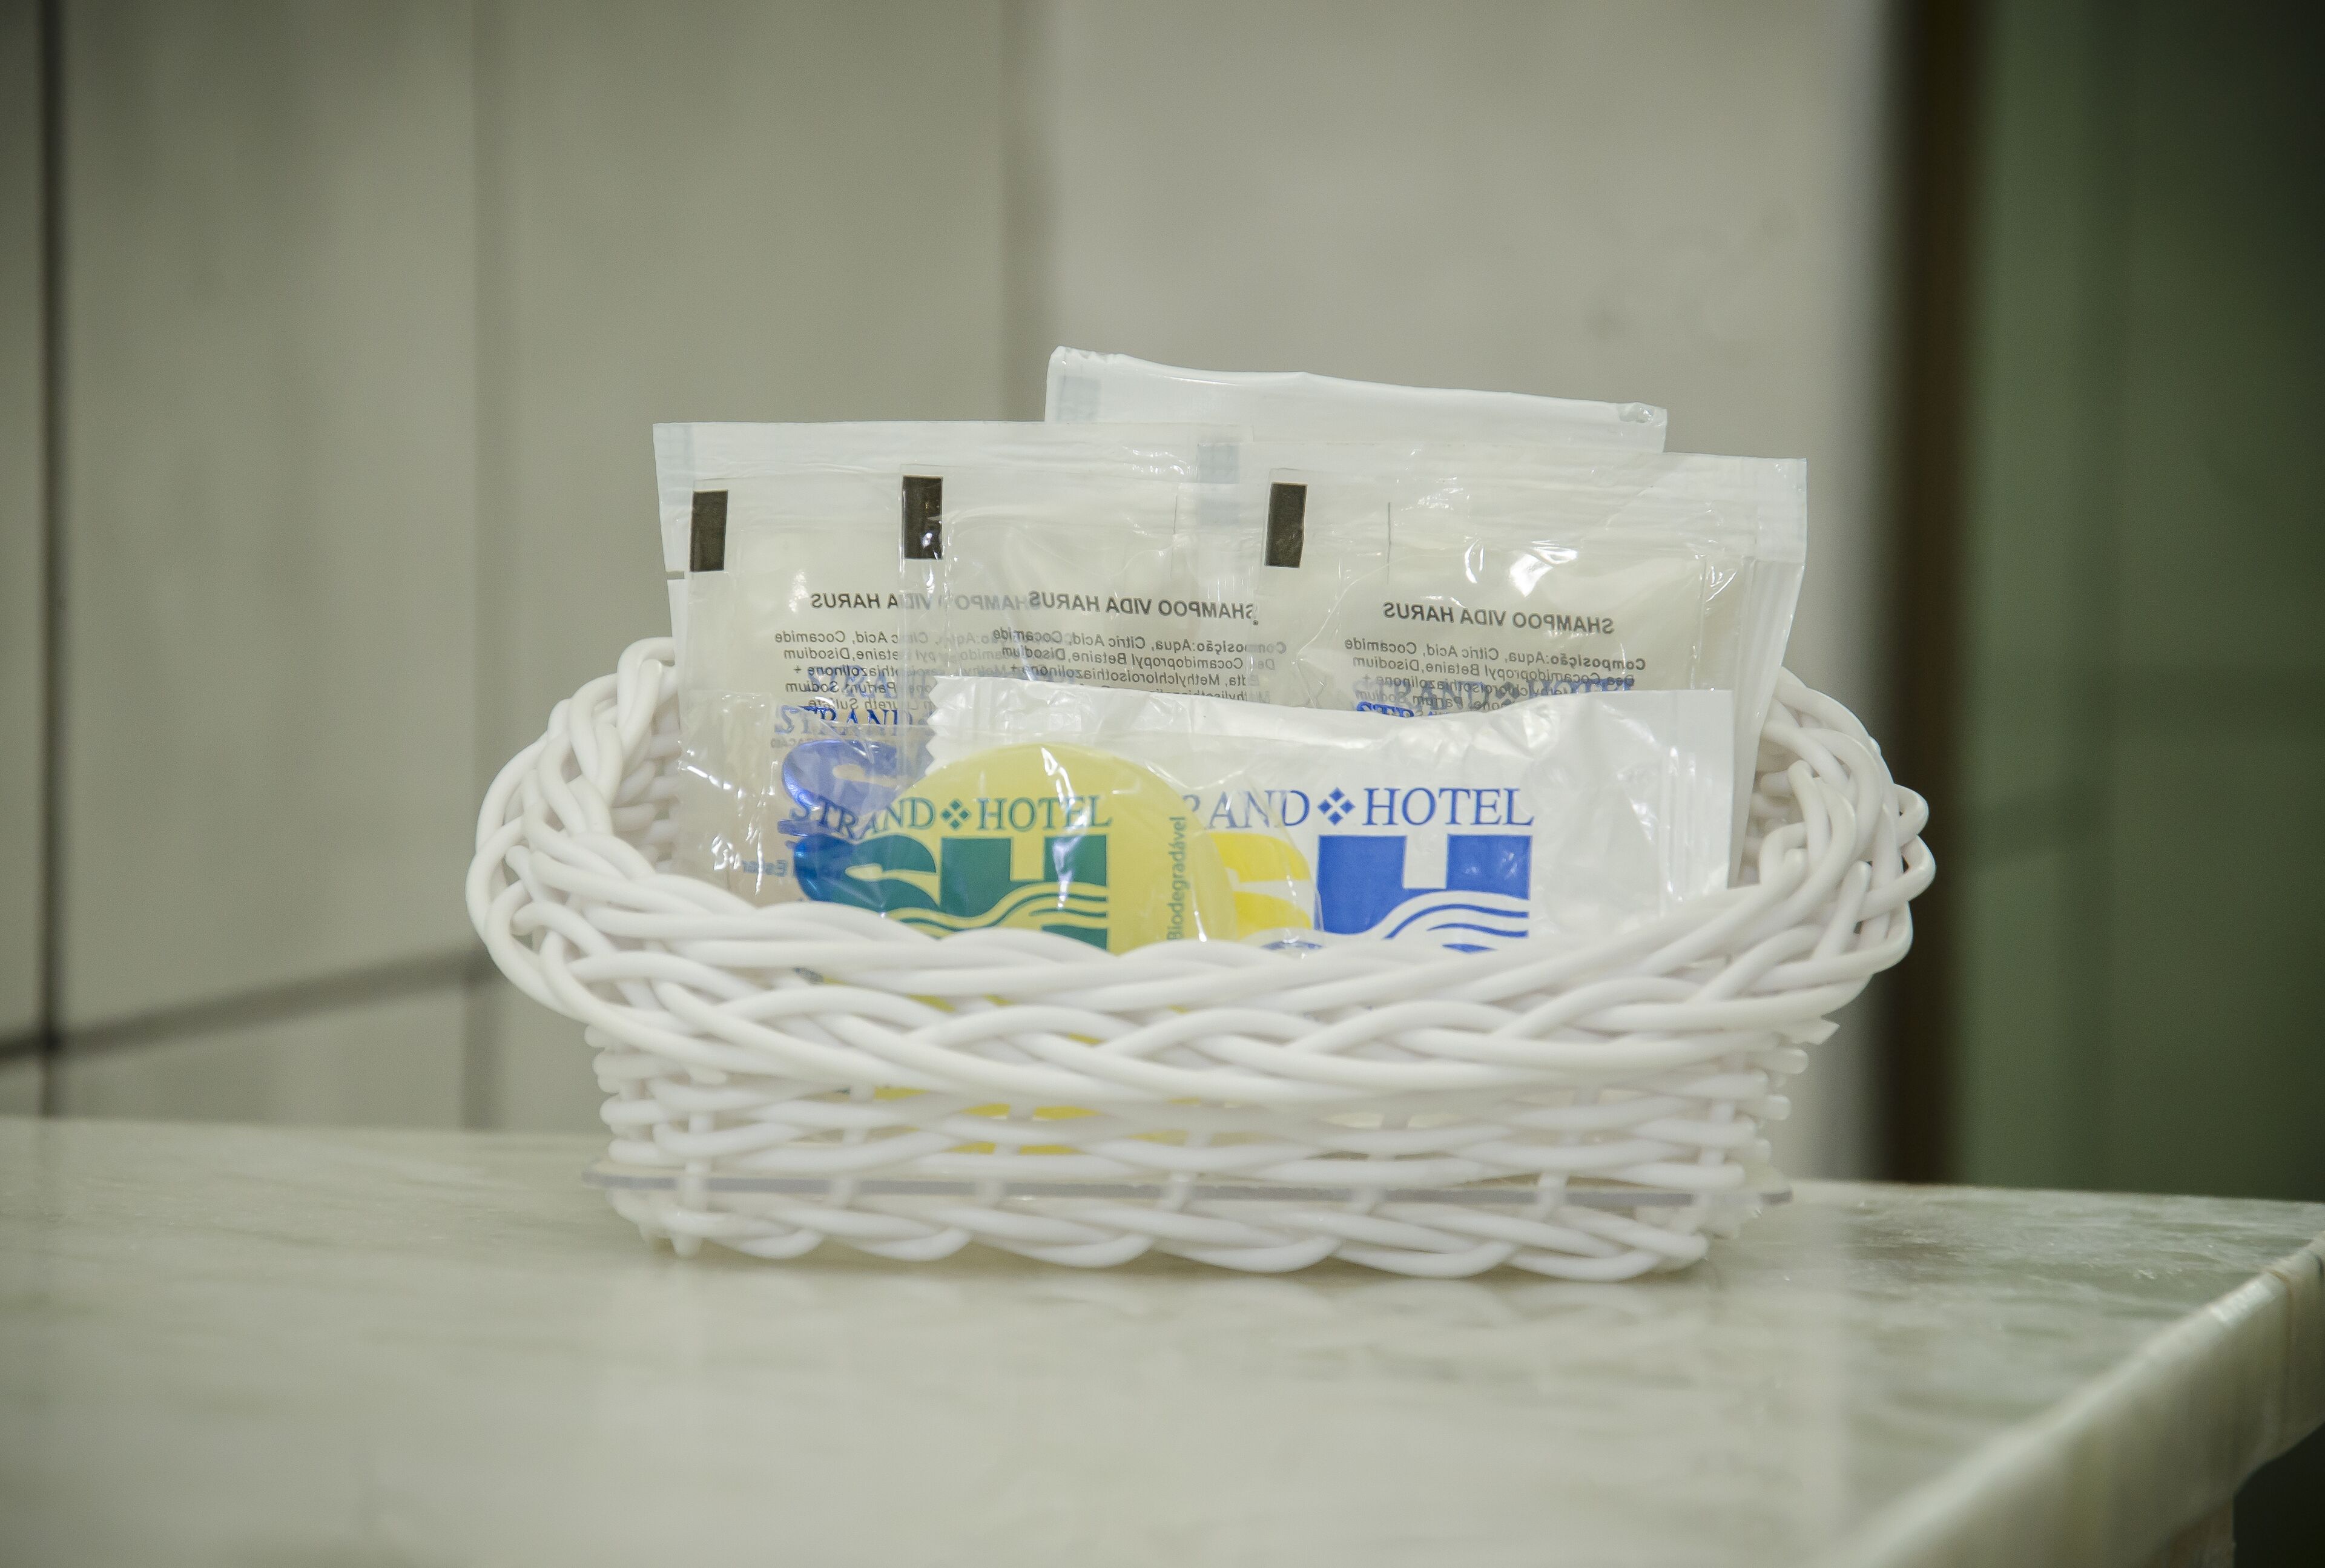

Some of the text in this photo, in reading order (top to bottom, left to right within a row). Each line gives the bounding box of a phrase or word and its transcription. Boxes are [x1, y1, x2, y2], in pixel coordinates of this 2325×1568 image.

[788, 794, 1113, 841] STRAND HOTEL
[1361, 788, 1535, 827] HOTEL
[1166, 815, 1191, 940] Biodegradável
